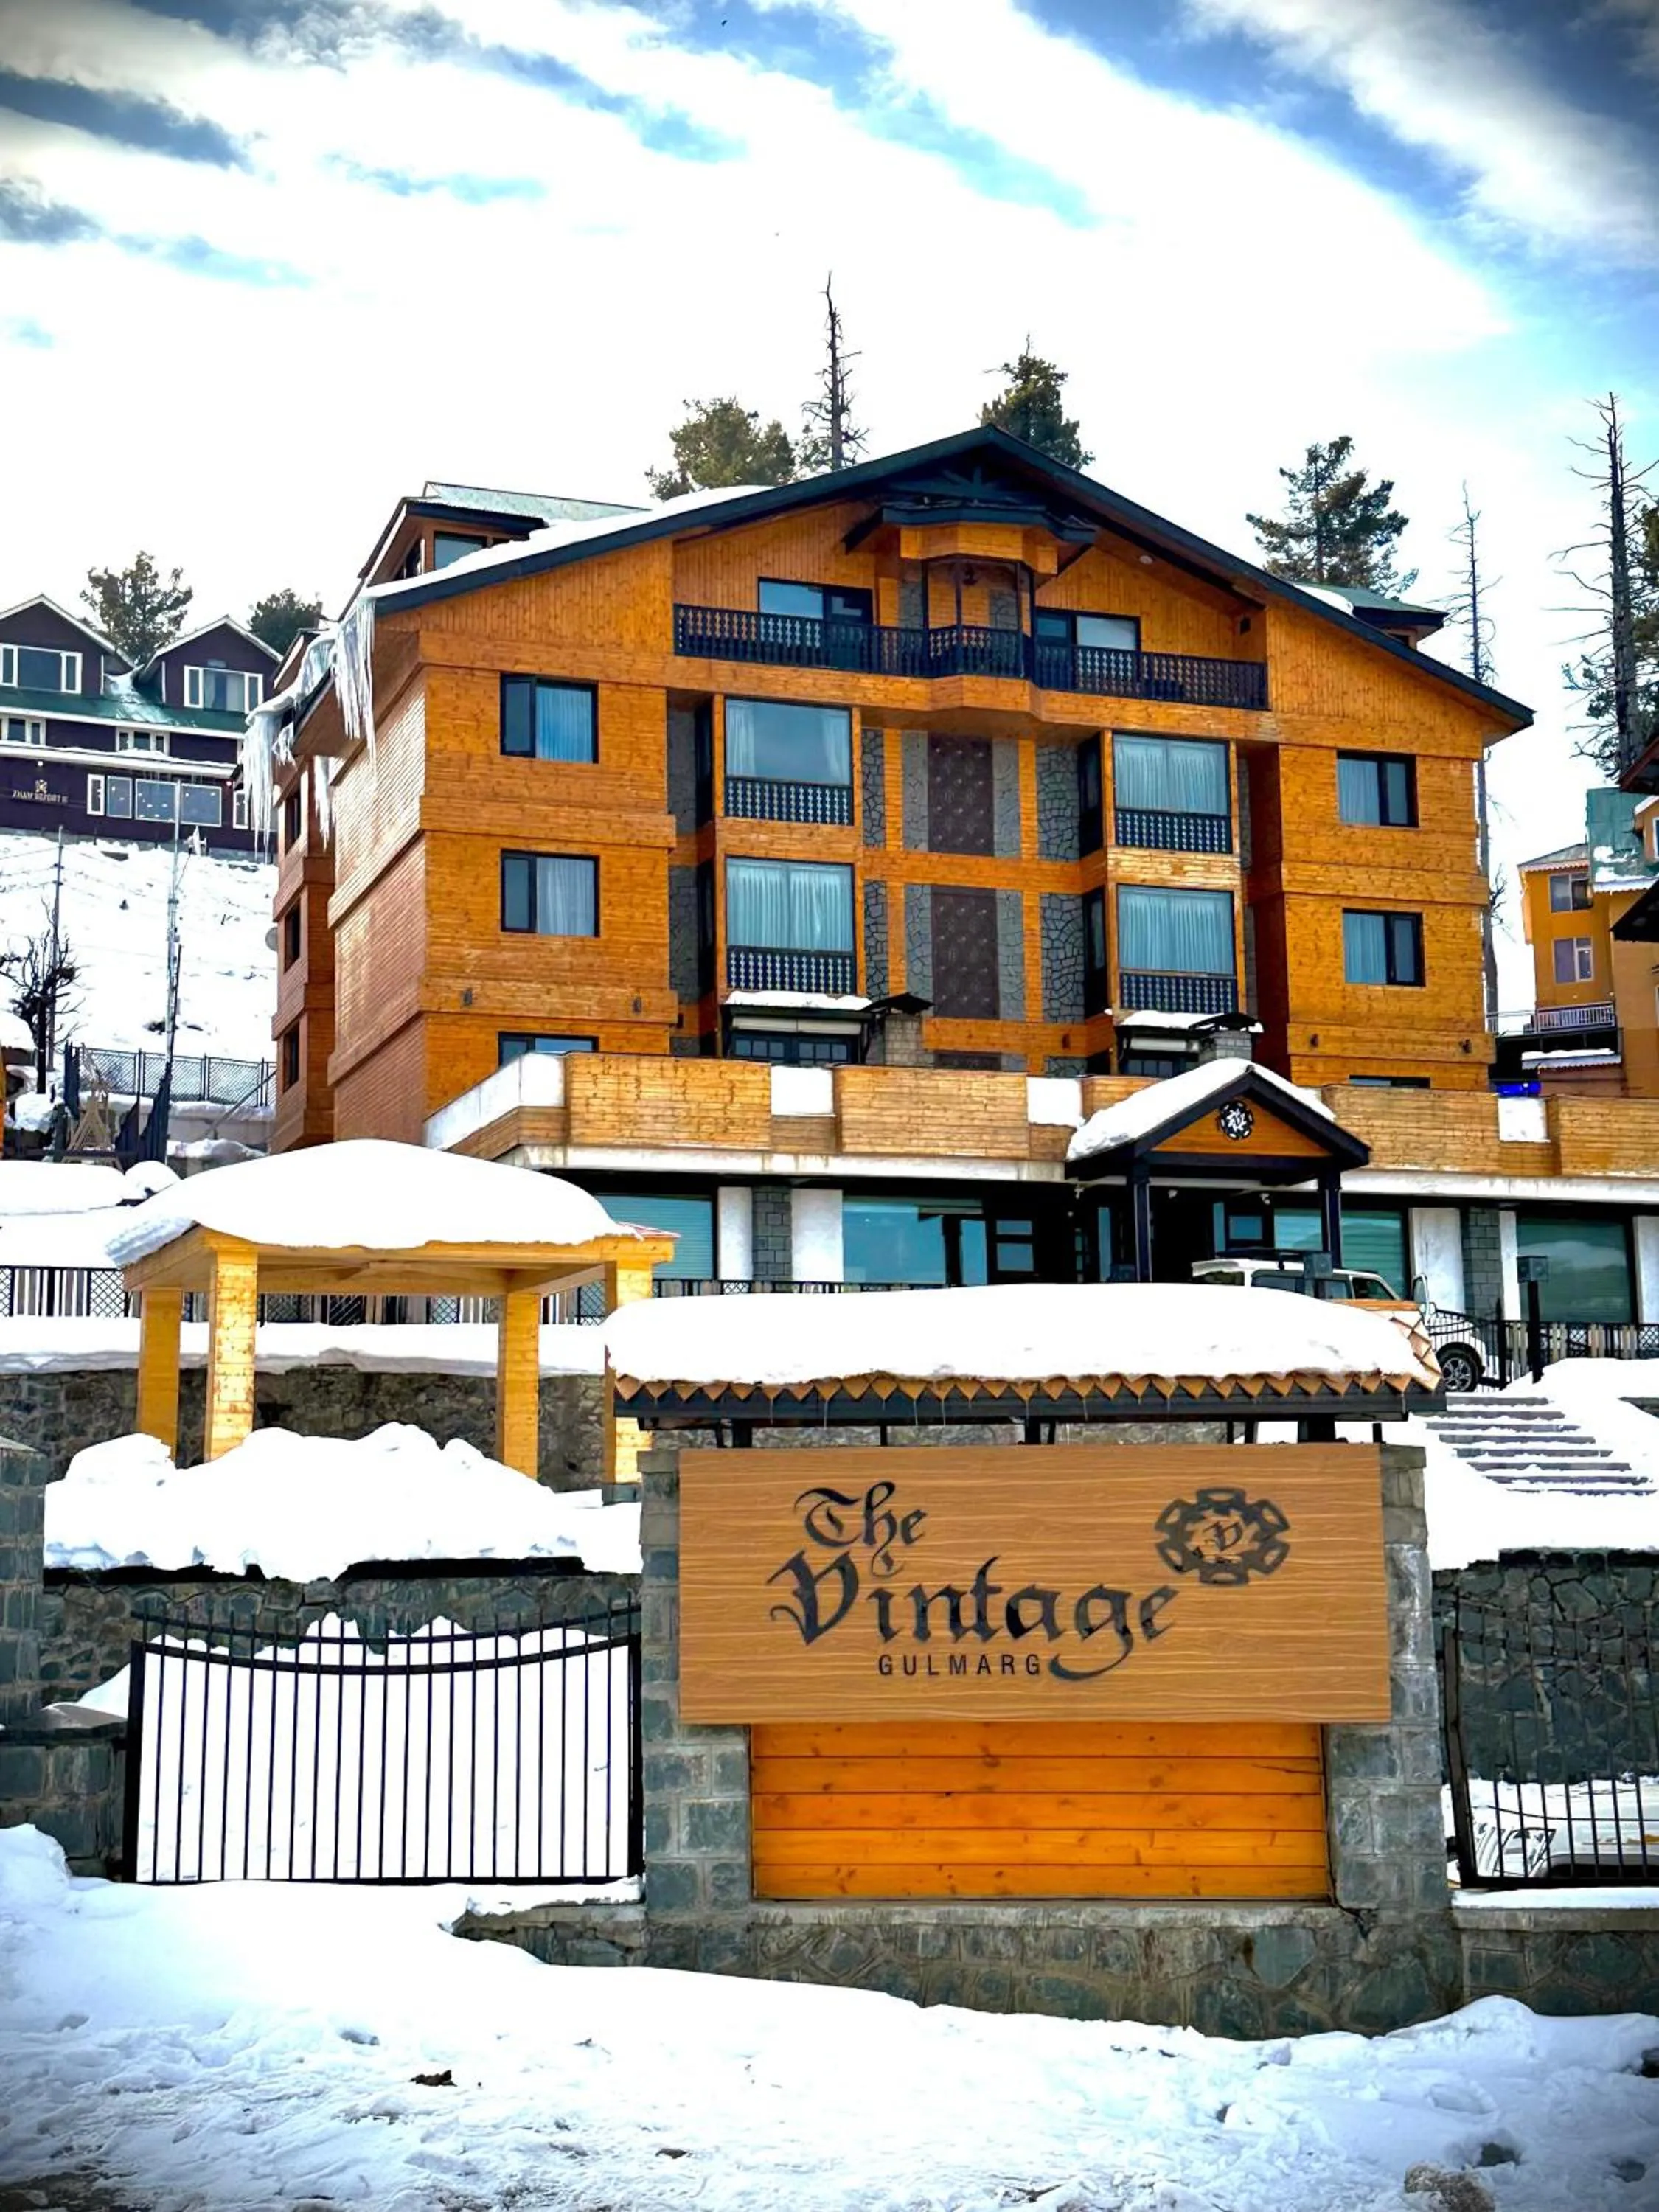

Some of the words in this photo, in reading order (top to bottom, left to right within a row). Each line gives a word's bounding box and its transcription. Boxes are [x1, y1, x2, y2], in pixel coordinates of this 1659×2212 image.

[793, 1481, 928, 1578] The
[766, 1550, 1179, 1680] Vintage
[878, 1653, 1040, 1676] GULMARG
